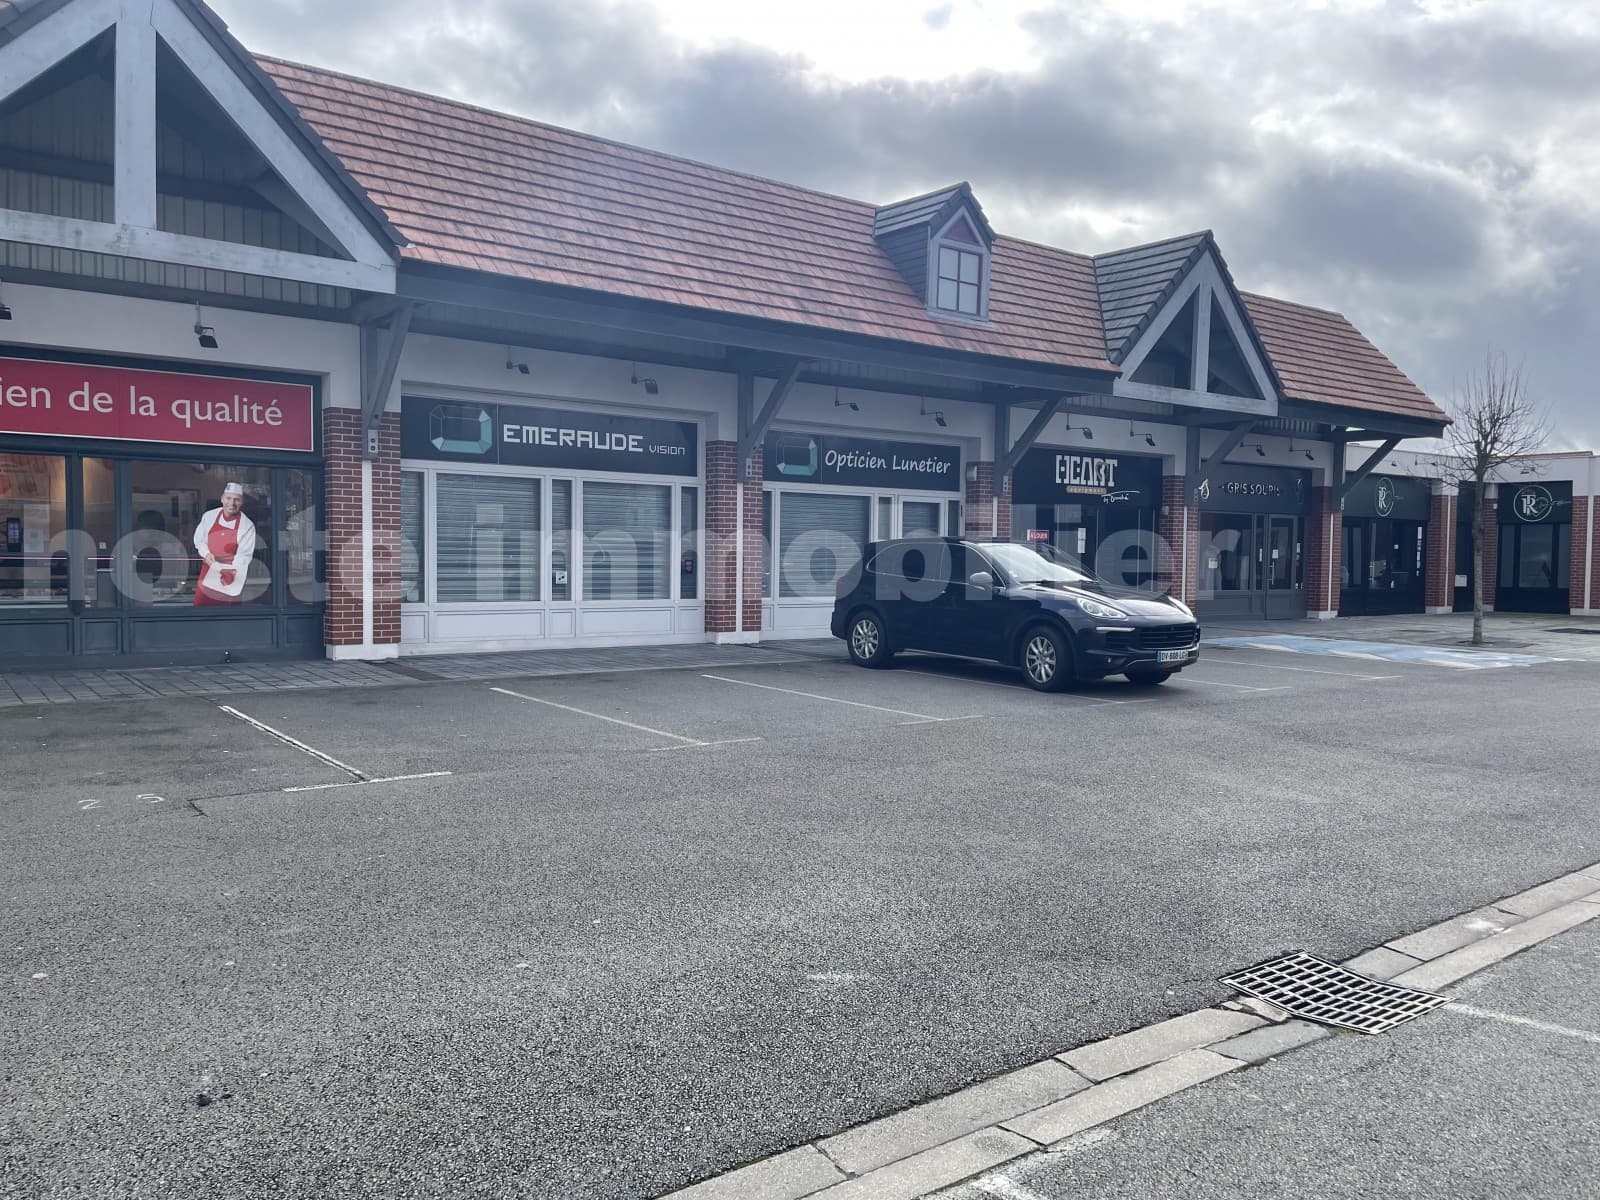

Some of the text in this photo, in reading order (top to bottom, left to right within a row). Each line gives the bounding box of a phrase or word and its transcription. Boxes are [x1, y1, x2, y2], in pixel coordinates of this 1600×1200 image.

[68, 381, 113, 413] de
[130, 385, 157, 417] la
[171, 394, 283, 428] qualité
[503, 424, 644, 452] EMERAUDE
[824, 449, 951, 474] Opticien Lunetier
[1055, 454, 1118, 487] HEART
